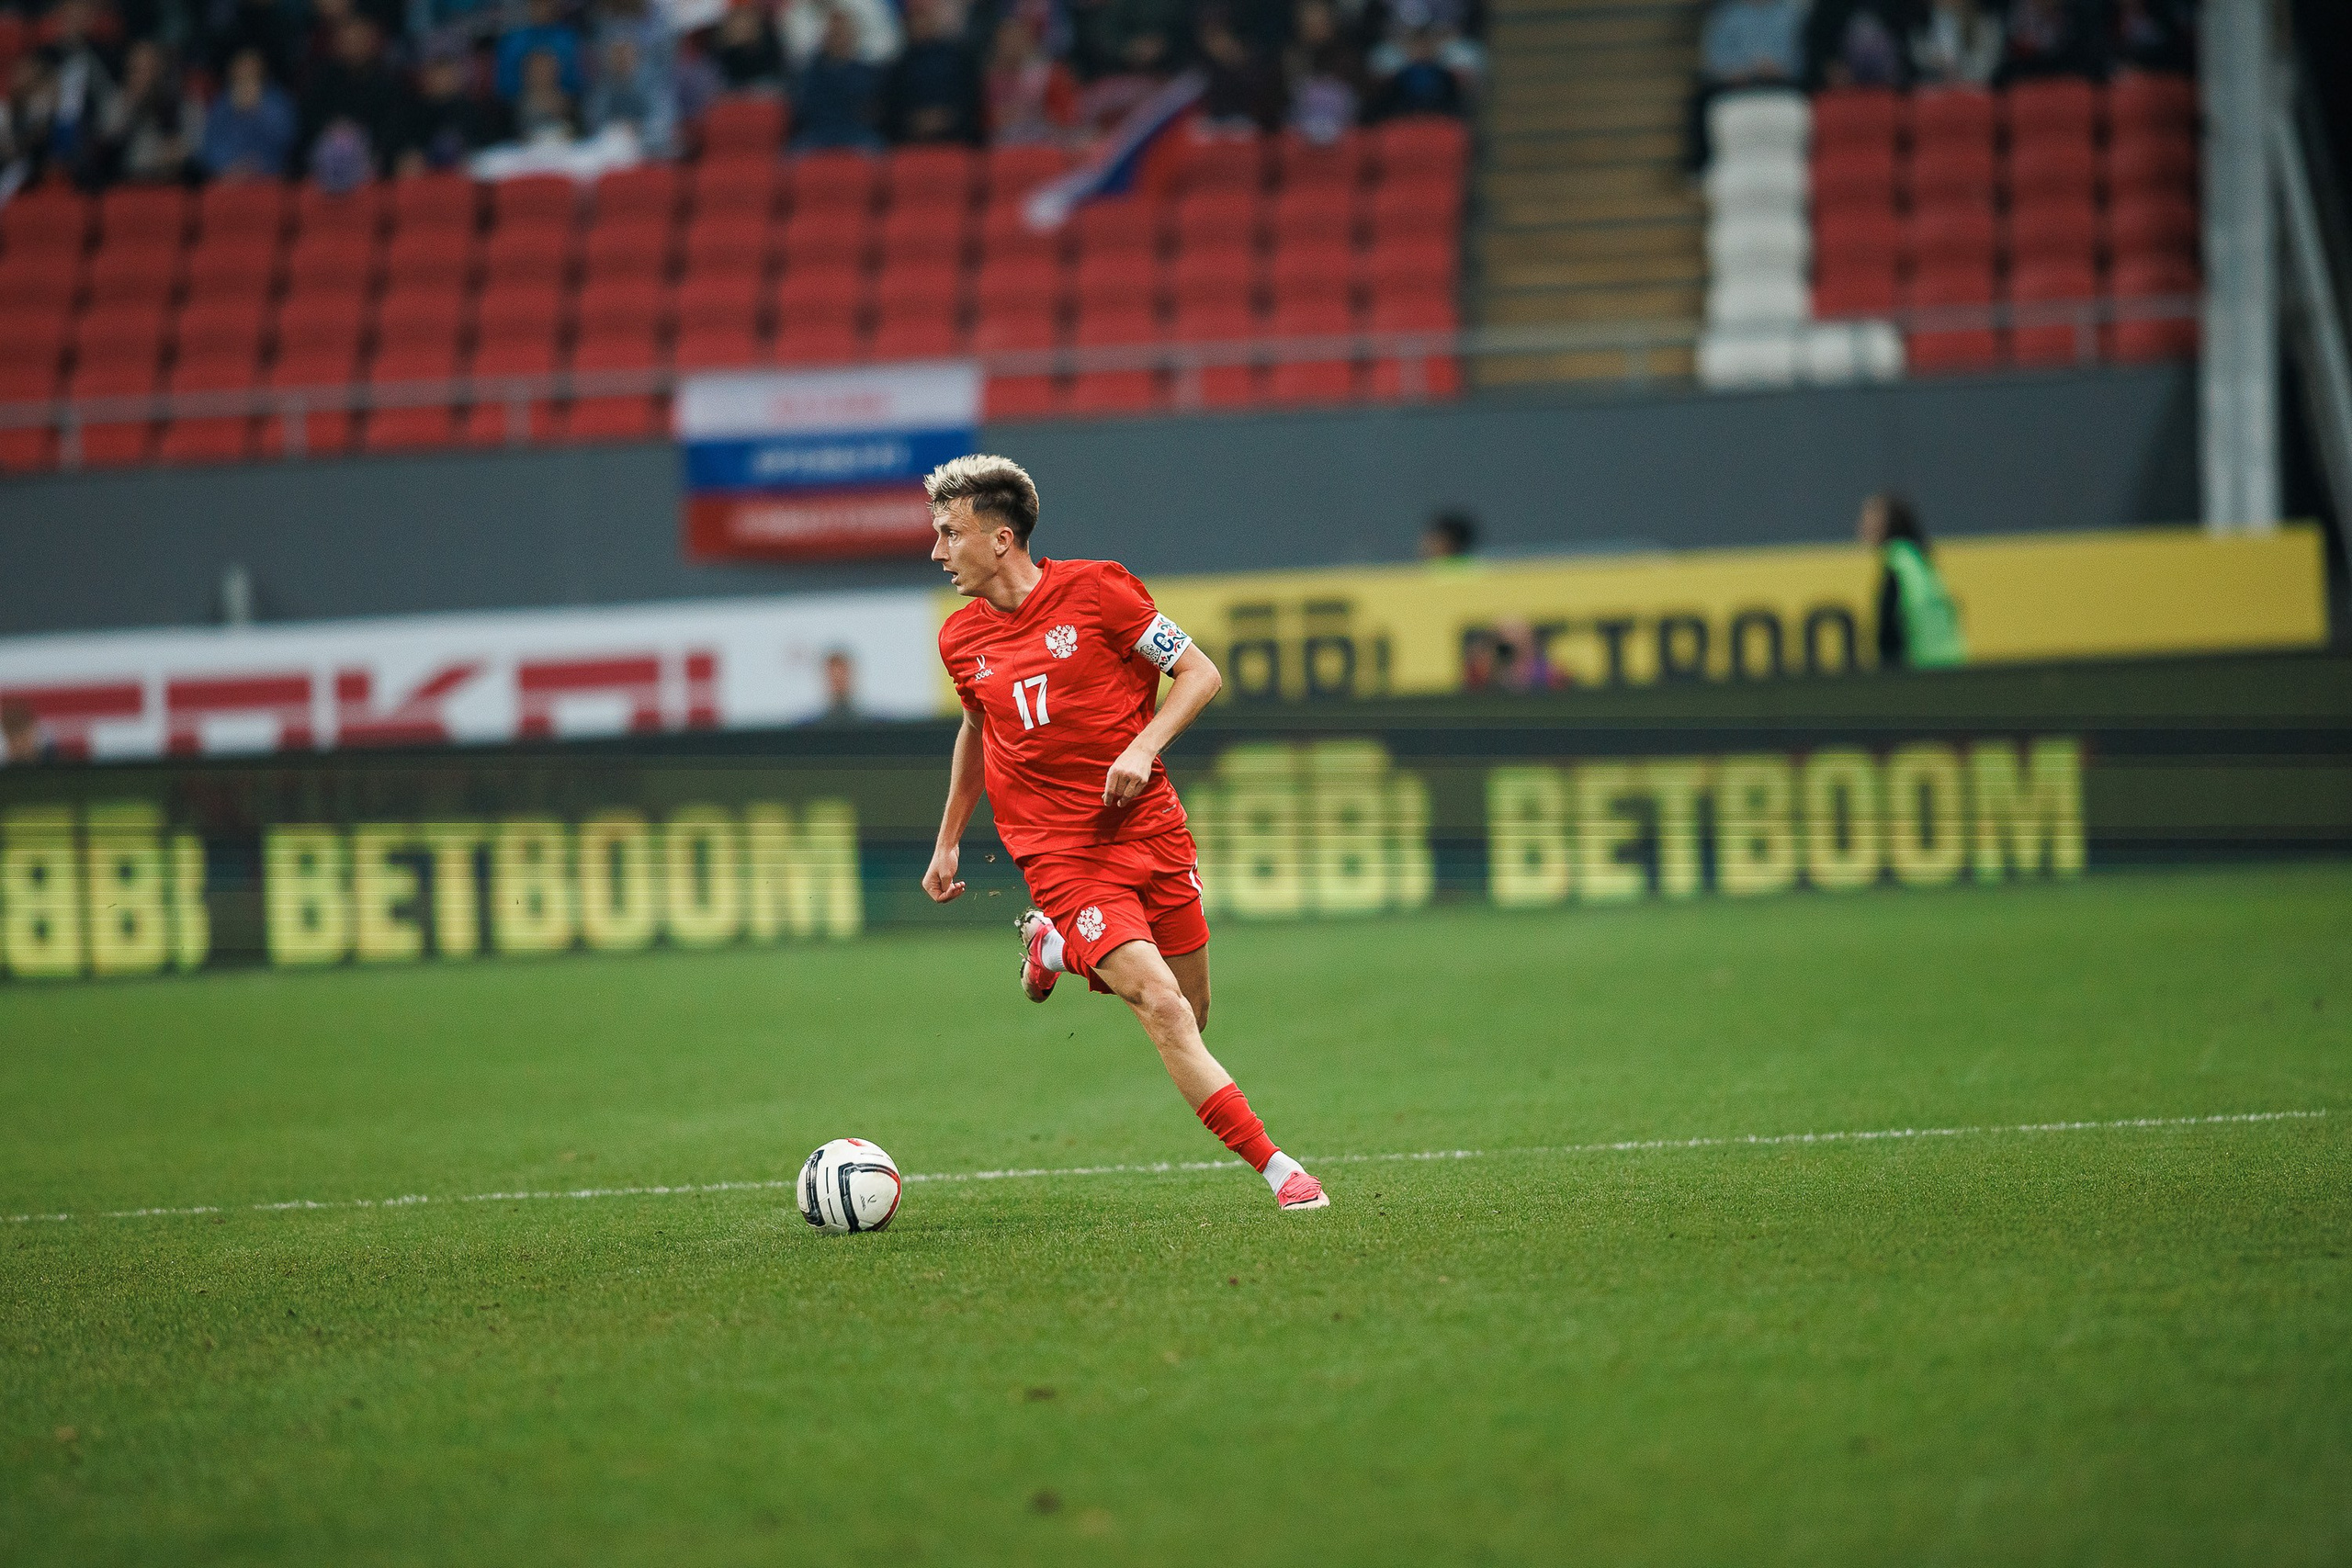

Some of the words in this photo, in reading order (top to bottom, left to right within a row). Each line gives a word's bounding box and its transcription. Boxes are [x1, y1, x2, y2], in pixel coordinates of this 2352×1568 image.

[1153, 632, 1174, 652] C
[1012, 673, 1051, 730] 17
[1487, 739, 2086, 908] BETBOOM
[267, 799, 862, 963] BETBOOM
